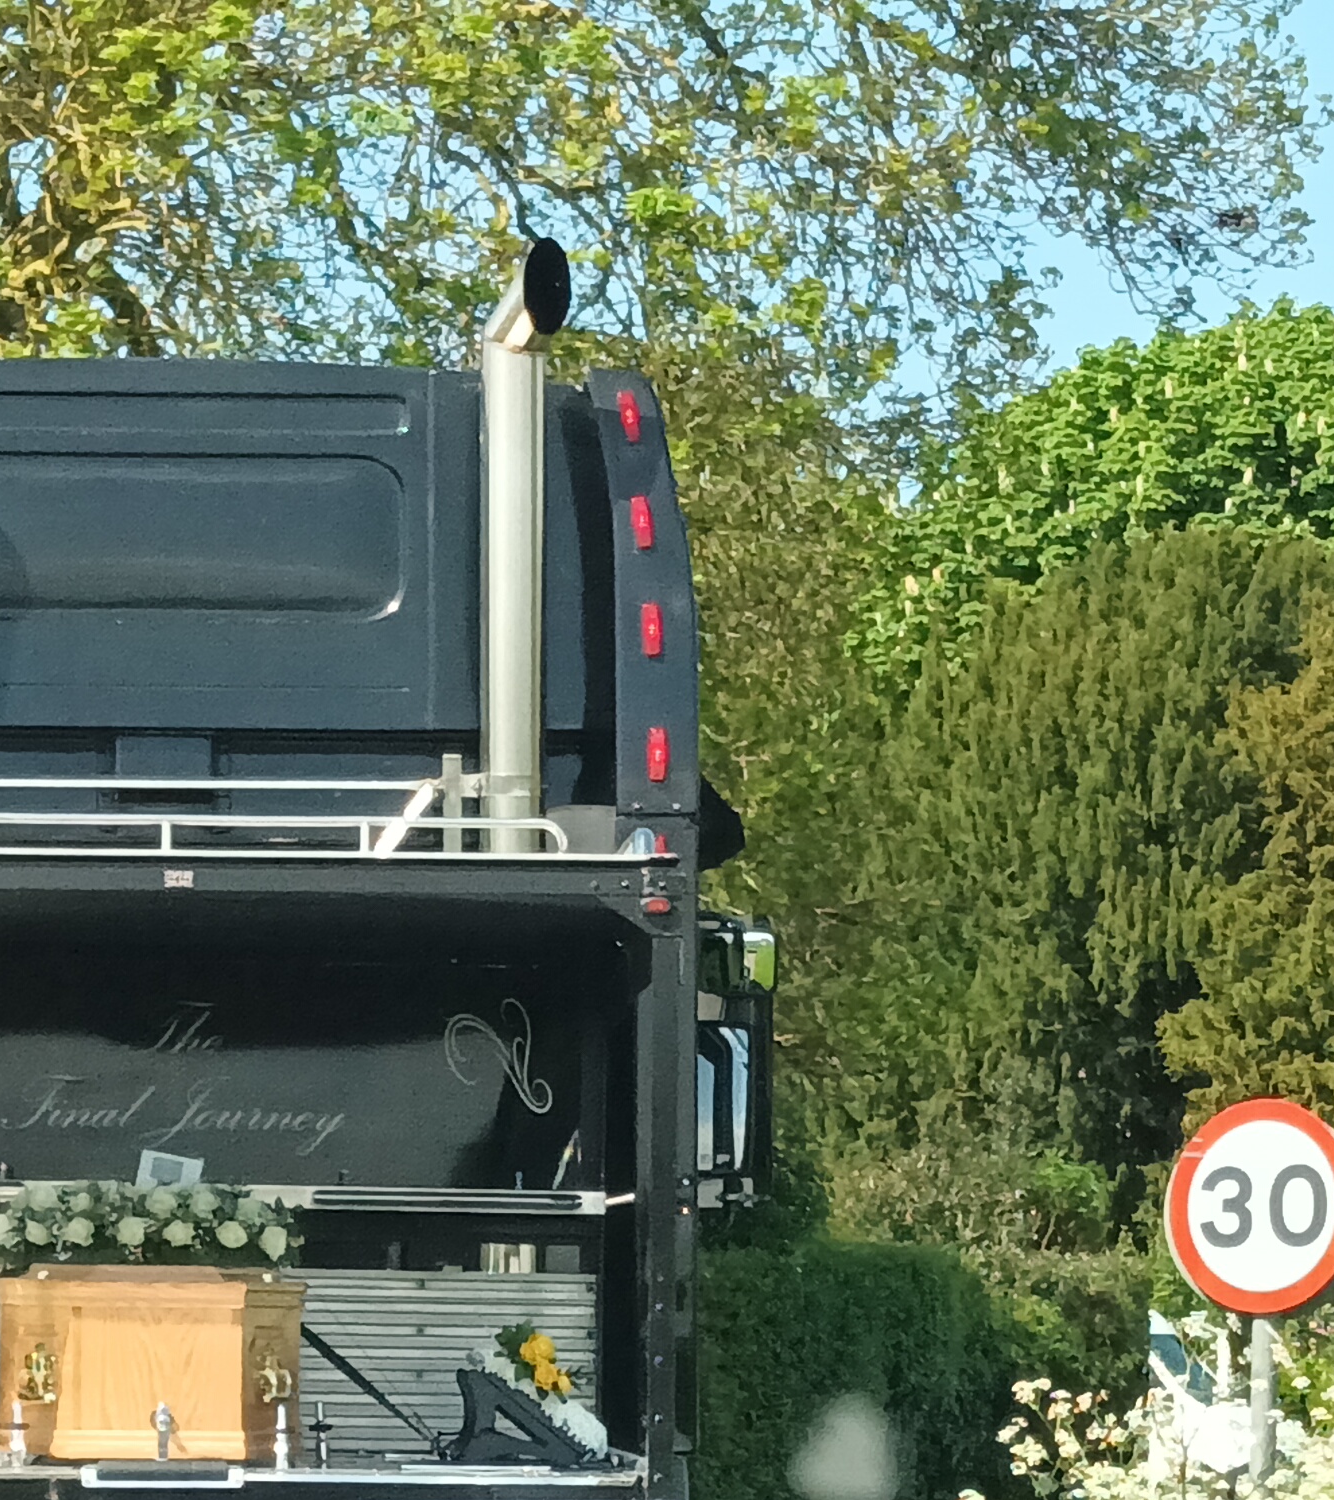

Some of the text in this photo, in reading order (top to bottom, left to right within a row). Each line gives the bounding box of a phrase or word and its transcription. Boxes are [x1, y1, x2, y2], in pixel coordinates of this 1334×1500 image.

[155, 1001, 224, 1055] The
[0, 1073, 348, 1157] Final Journey
[1200, 1163, 1328, 1249] 30
